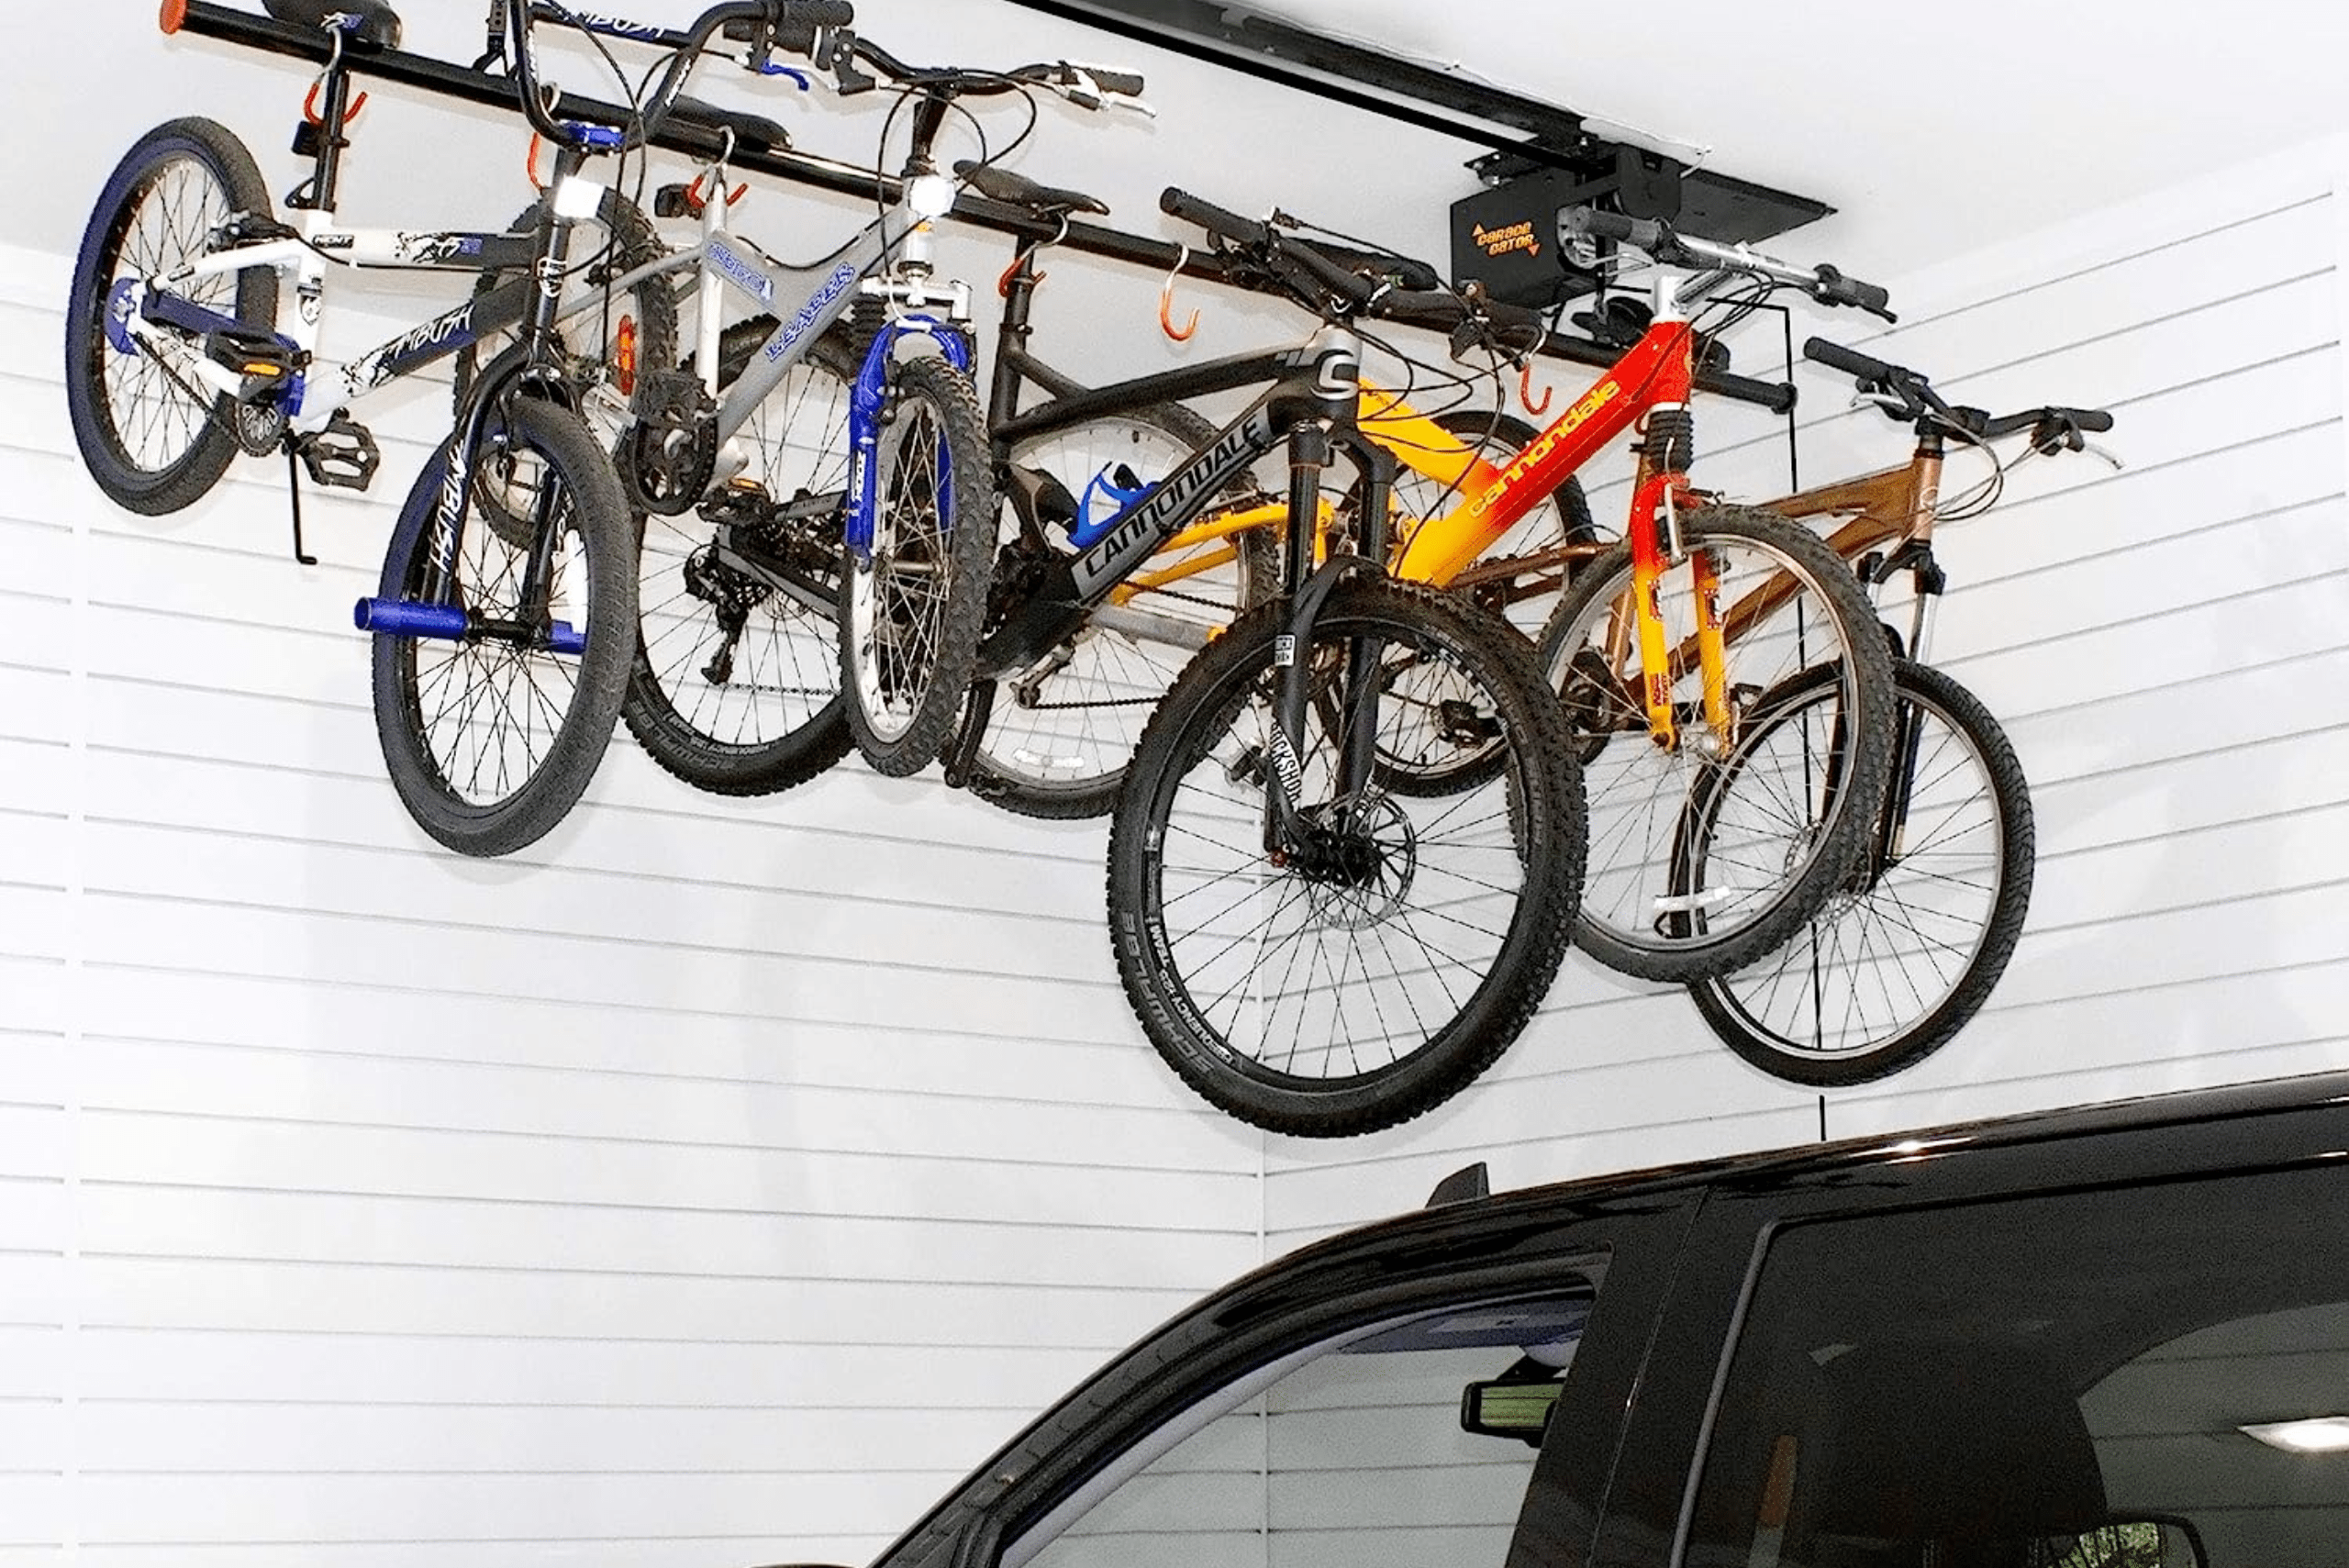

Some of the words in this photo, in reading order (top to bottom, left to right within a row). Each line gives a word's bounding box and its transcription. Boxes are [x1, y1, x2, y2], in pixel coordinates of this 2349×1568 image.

[1487, 233, 1534, 256] GATOR
[1085, 416, 1263, 578] CANNONDALE
[1468, 379, 1620, 517] cannondale
[1121, 911, 1215, 1073] SCHWALBE
[1149, 924, 1171, 967] TEAM
